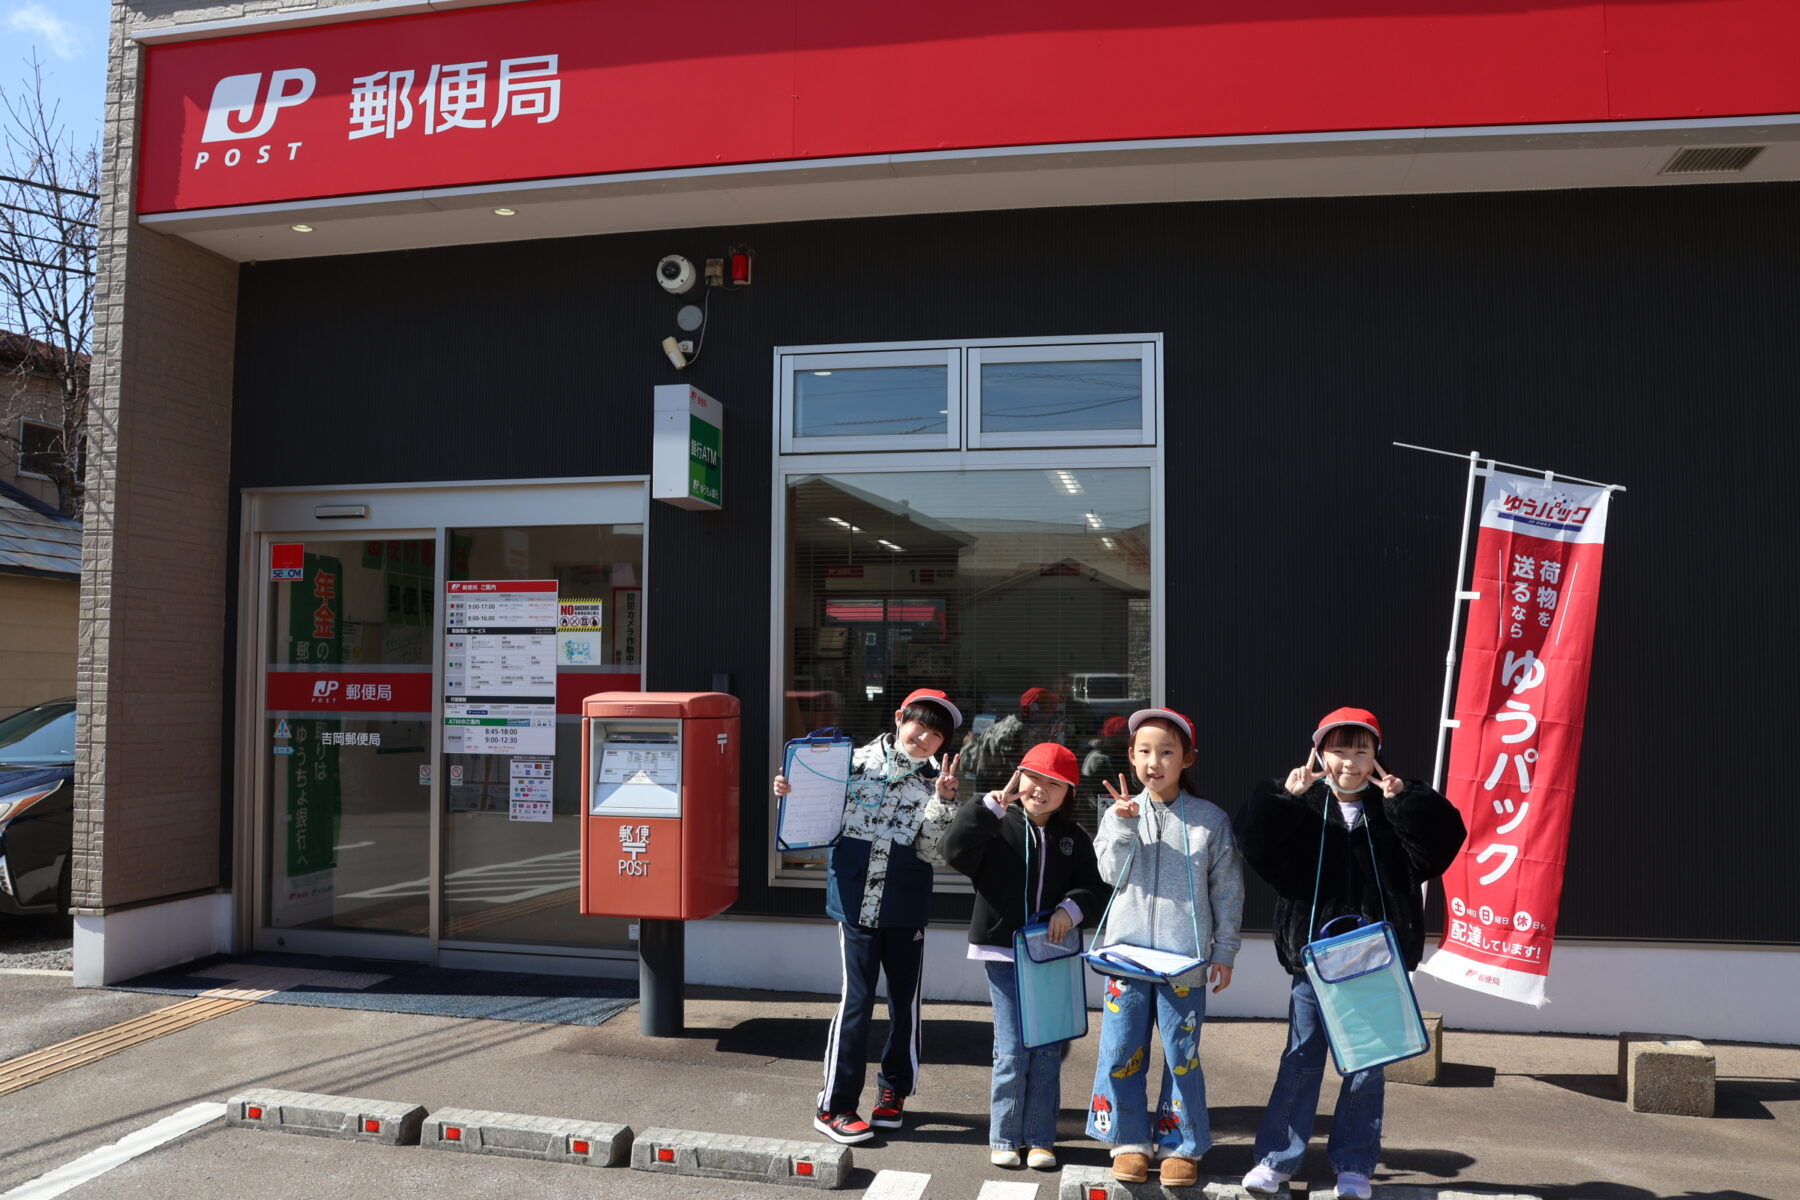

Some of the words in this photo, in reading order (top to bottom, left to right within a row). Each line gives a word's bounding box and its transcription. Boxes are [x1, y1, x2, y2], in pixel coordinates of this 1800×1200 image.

[348, 54, 561, 140] 郵便局
[195, 142, 303, 170] POST
[1503, 494, 1592, 524] ゆうパック
[1510, 553, 1535, 638] 送るなら
[1536, 560, 1561, 627] 荷物を
[560, 605, 574, 615] NO
[346, 684, 392, 701] 郵便局
[321, 732, 381, 747] 吉岡郵便局
[1476, 649, 1546, 885] ゆうパック
[619, 825, 650, 844] 郵便
[618, 860, 650, 876] POST
